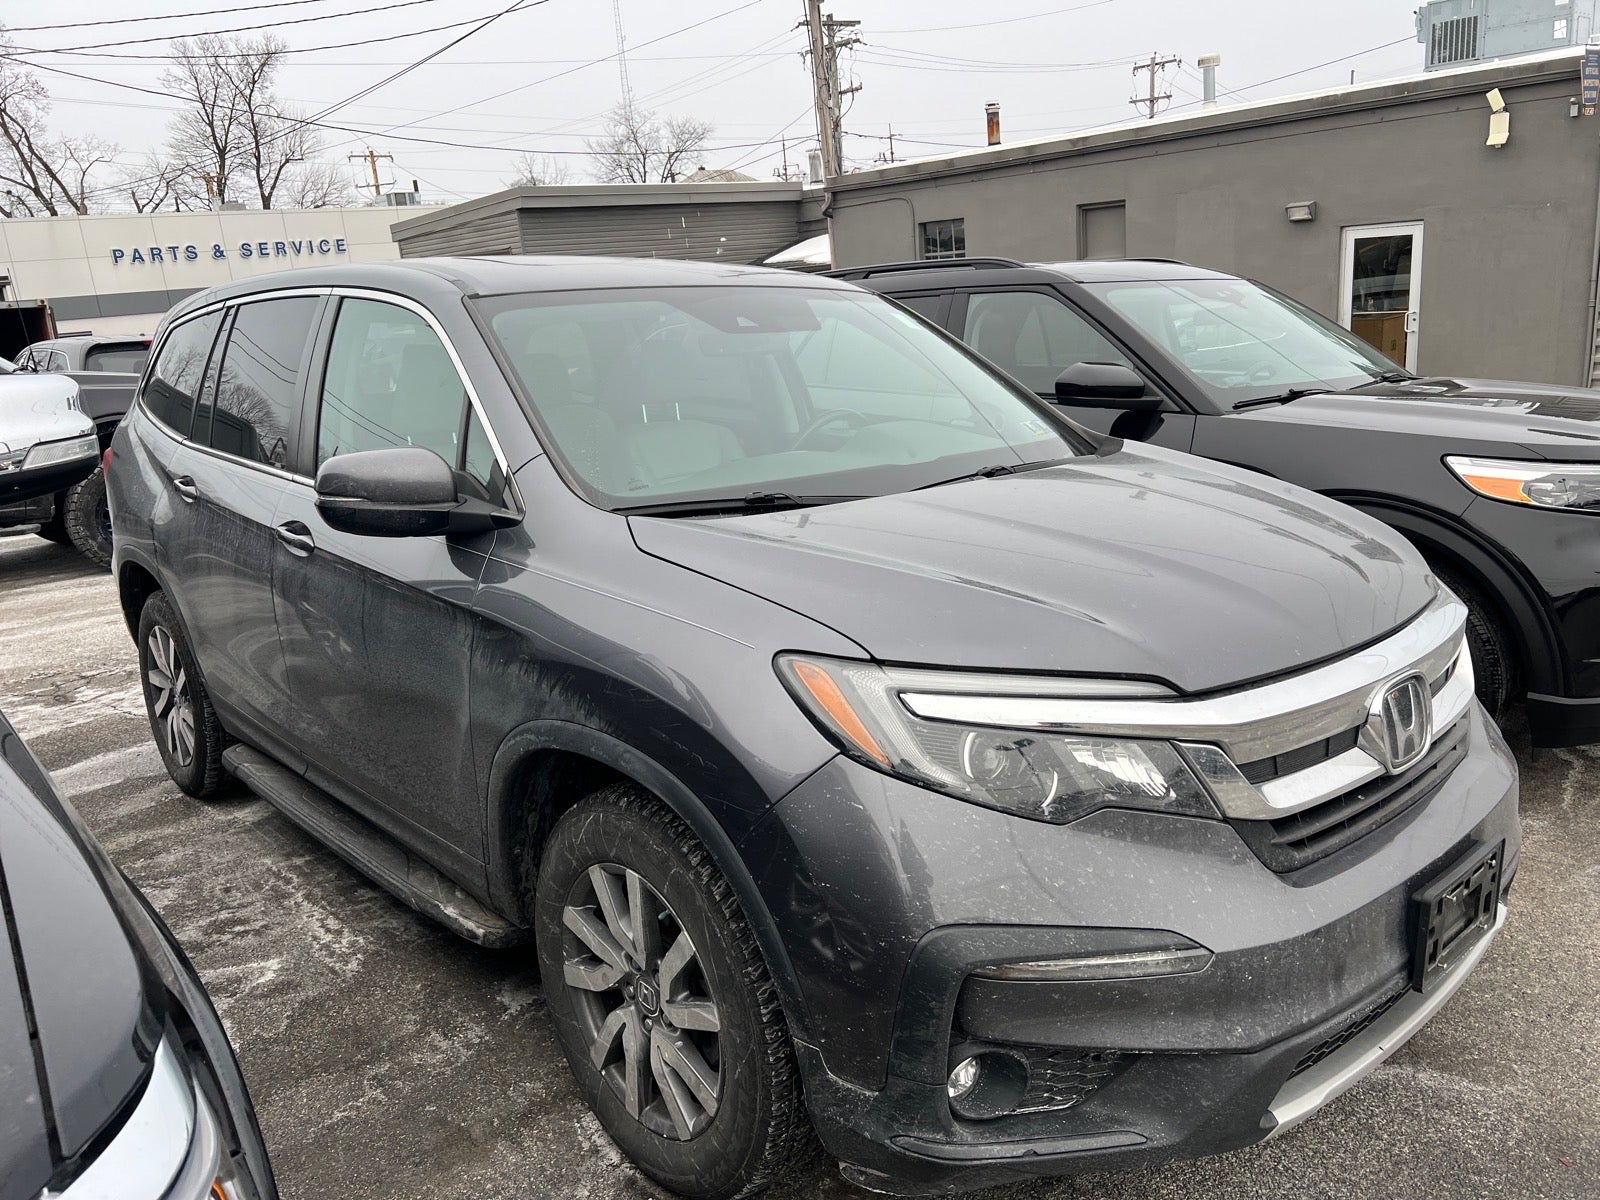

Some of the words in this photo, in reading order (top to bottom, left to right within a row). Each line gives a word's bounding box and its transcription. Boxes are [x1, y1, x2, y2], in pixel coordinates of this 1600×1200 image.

[112, 245, 199, 264] PARTS
[212, 243, 226, 260] &
[240, 238, 348, 258] SERVICE
